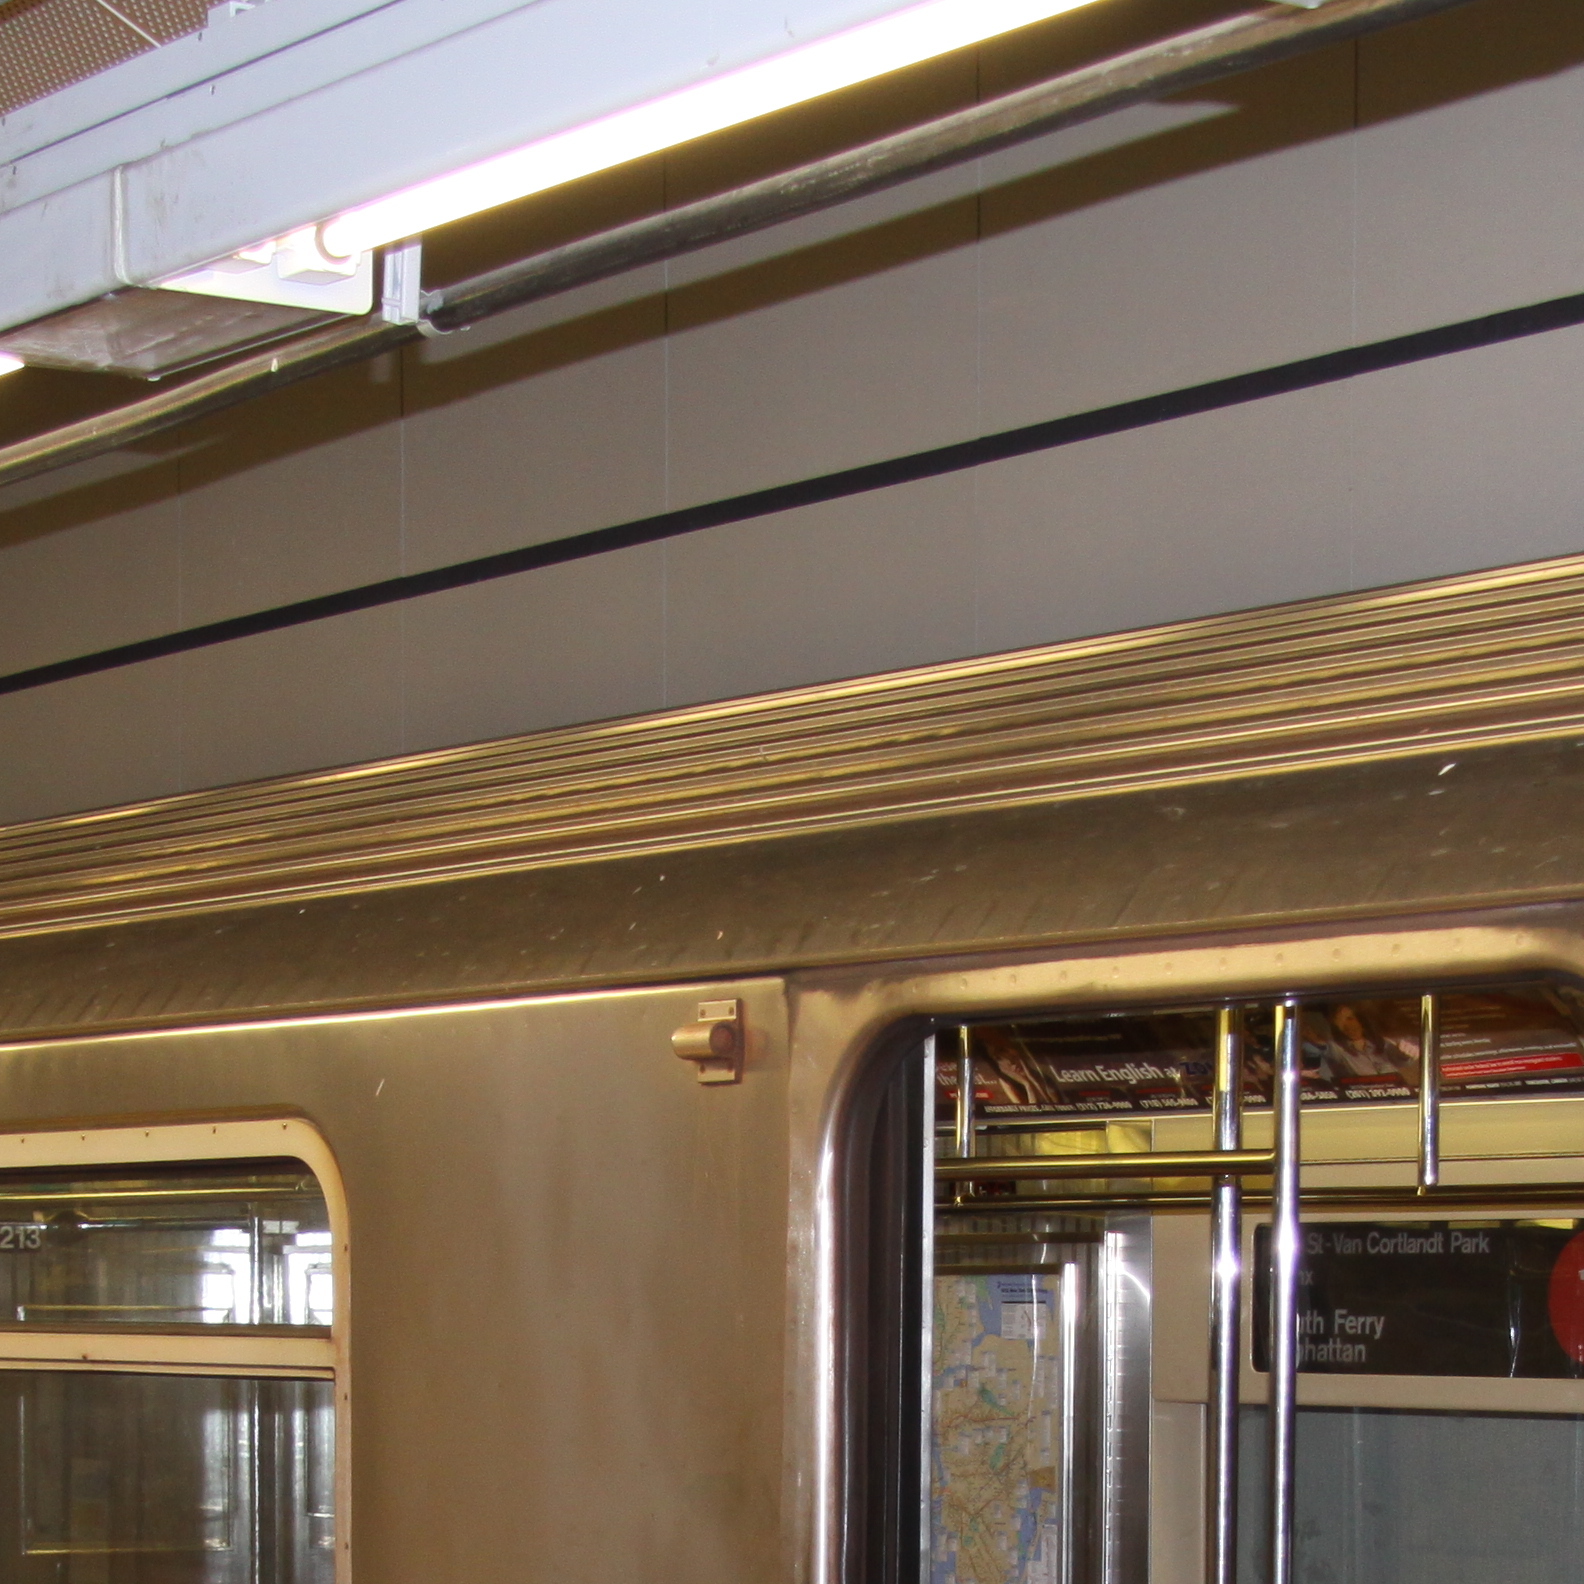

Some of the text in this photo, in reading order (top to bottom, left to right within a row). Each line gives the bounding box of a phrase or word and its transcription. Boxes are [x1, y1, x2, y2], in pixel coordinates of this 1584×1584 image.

[1050, 1064, 1098, 1084] Learn
[1097, 1062, 1165, 1085] English
[1366, 1231, 1444, 1255] Cortlandt
[1450, 1233, 1490, 1254] Park
[1334, 1309, 1385, 1340] Ferry
